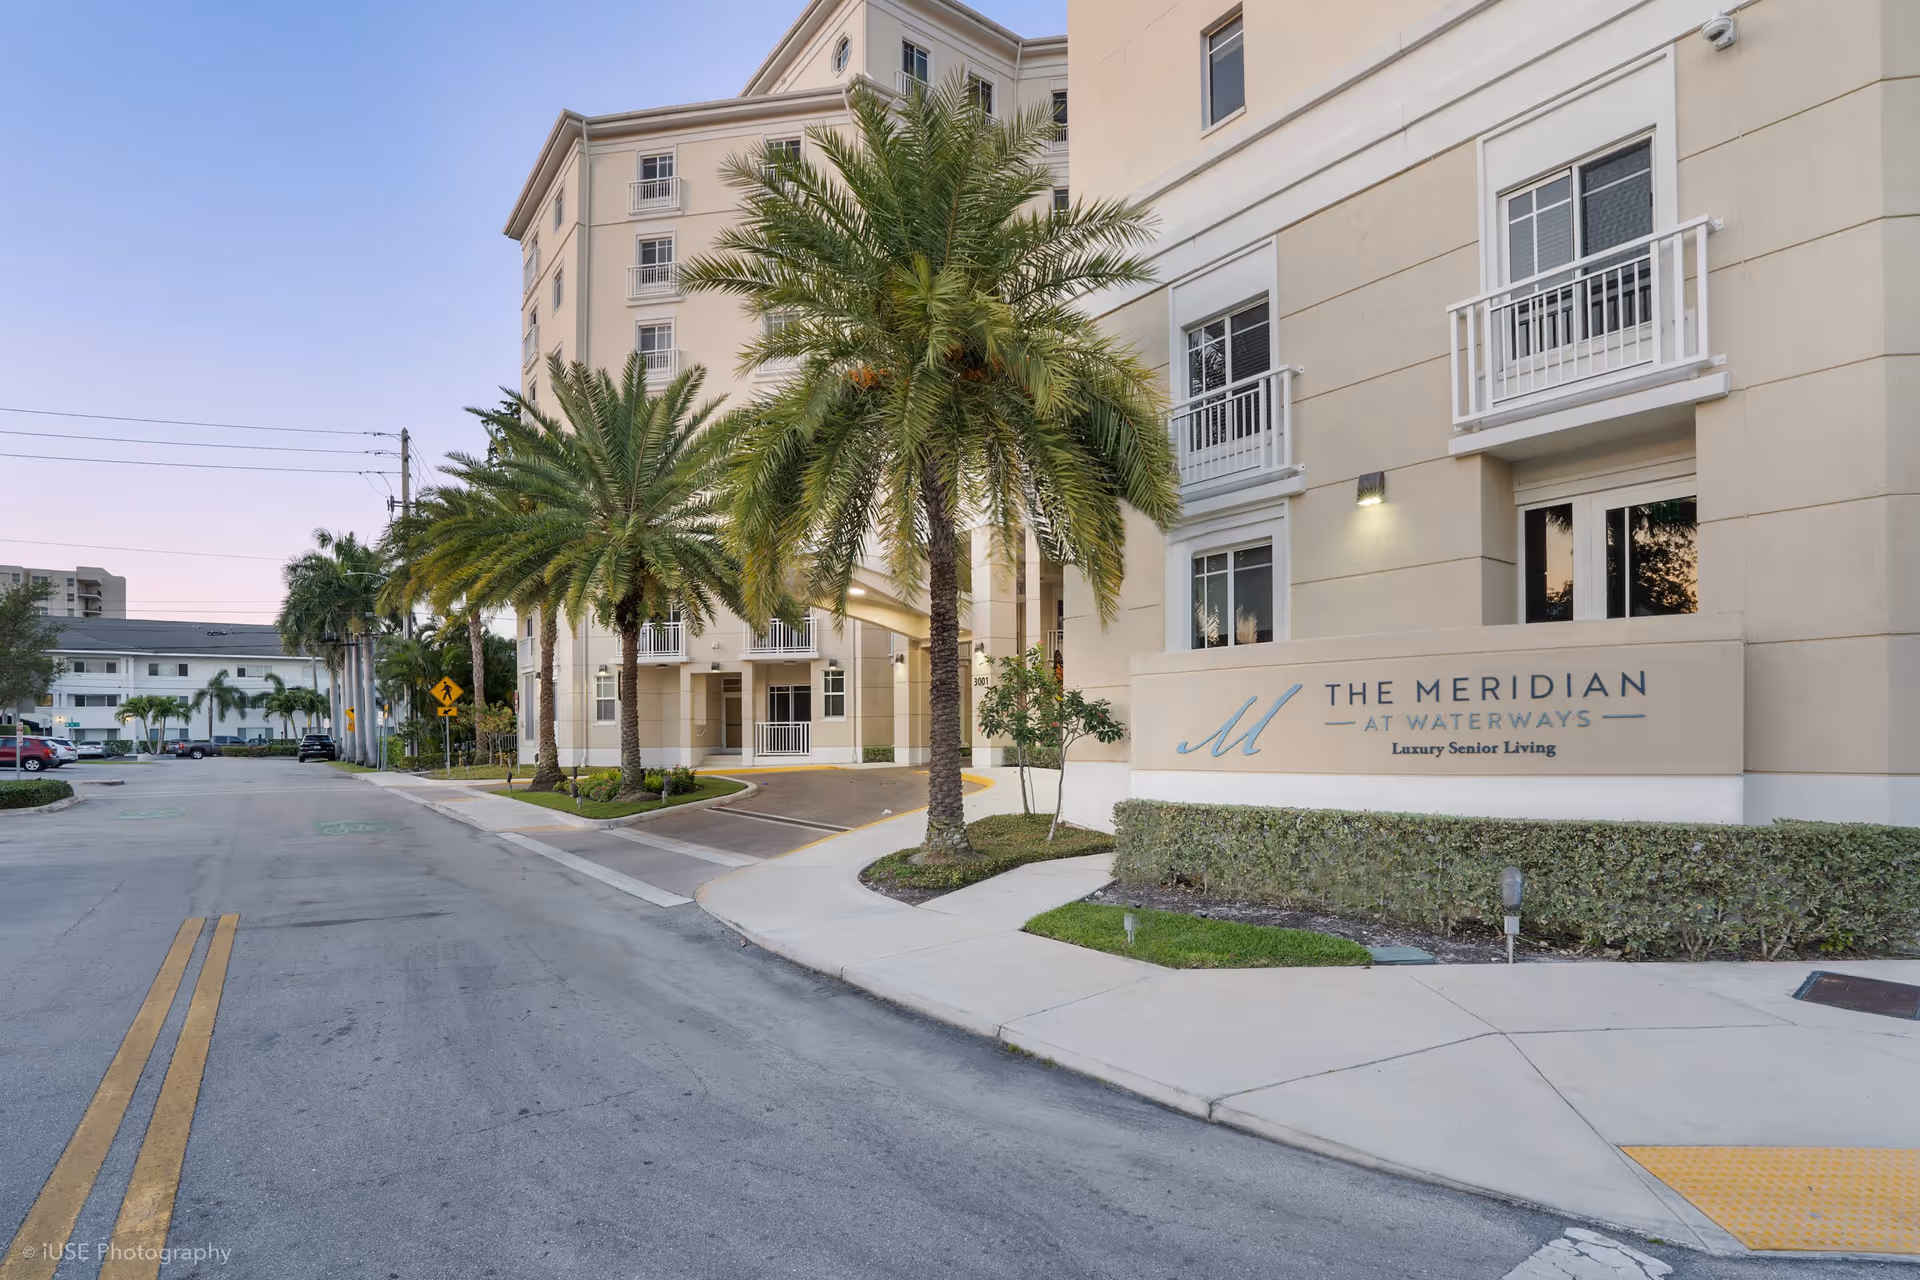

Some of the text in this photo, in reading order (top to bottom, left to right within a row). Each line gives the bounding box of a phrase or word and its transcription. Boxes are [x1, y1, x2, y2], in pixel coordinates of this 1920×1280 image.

[974, 677, 988, 686] 3001
[1325, 670, 1646, 706] THE MERIDIAN
[1364, 709, 1590, 732] AT WATERWAYS
[1391, 741, 1556, 758] Luxury Senior Living
